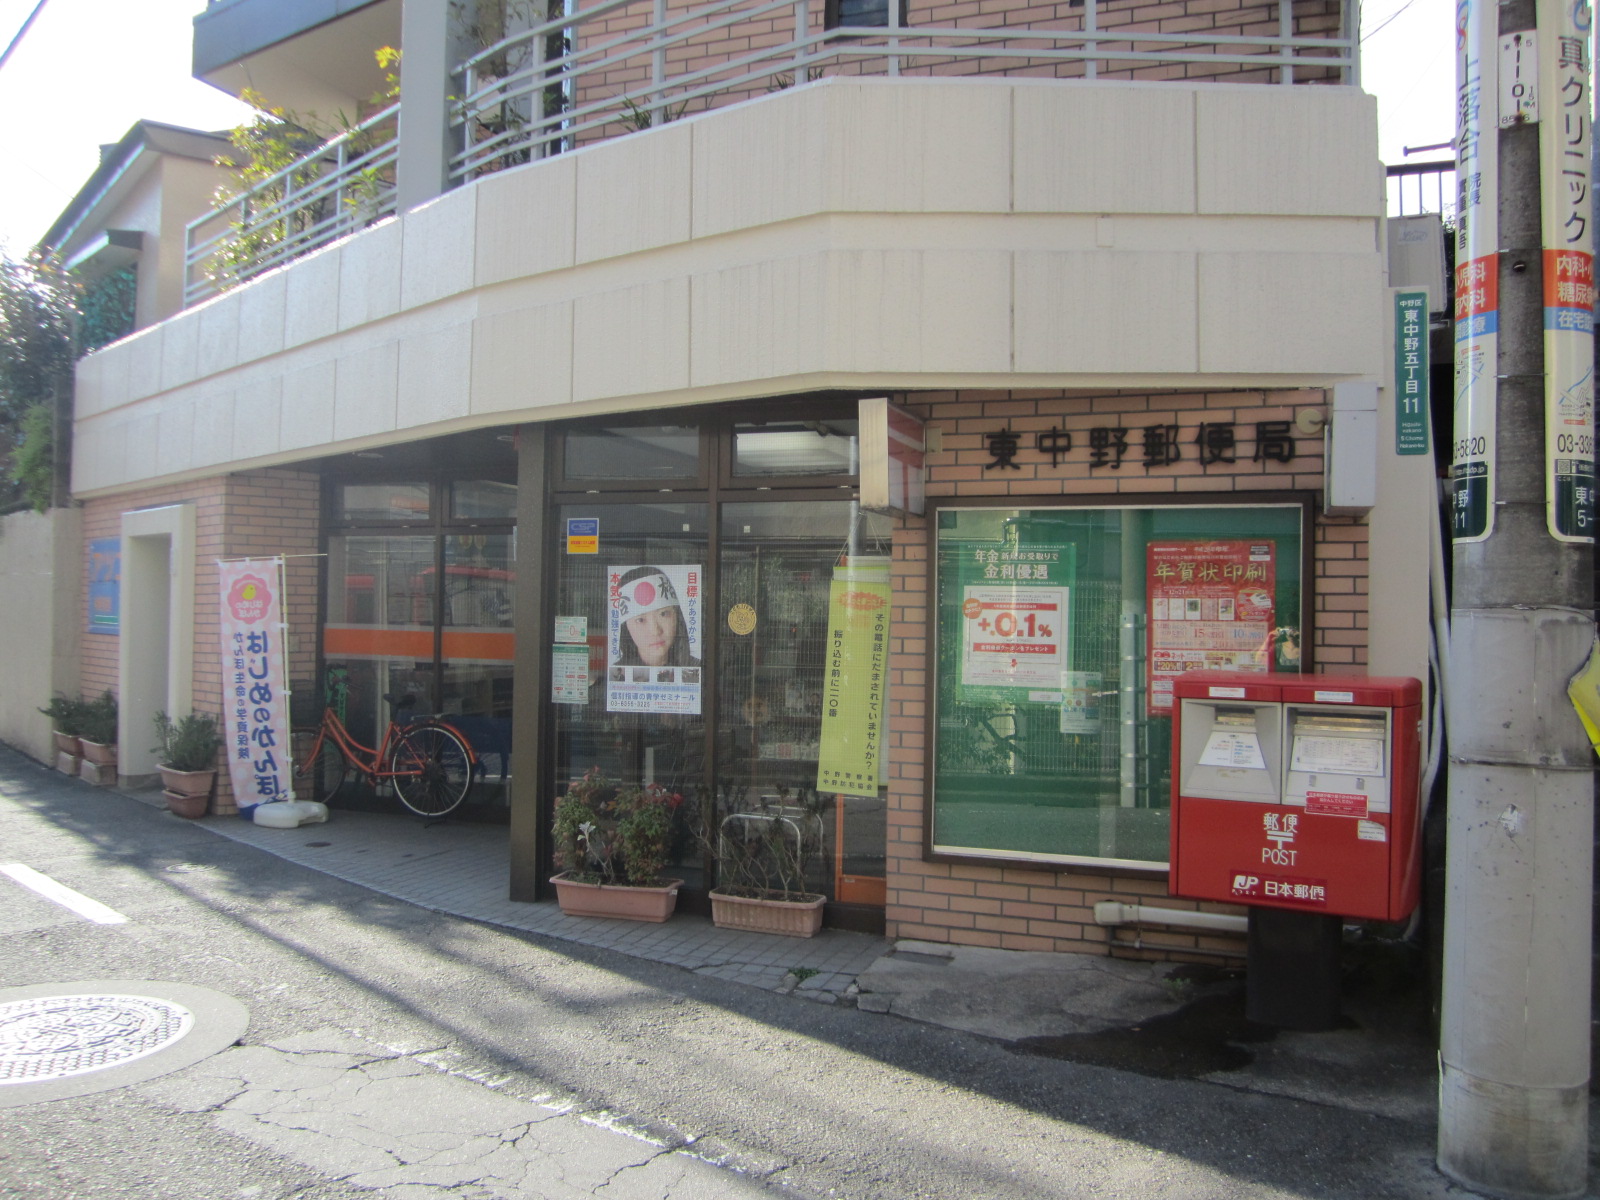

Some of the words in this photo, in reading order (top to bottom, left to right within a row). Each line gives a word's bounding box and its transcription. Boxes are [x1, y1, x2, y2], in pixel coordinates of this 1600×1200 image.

[1557, 35, 1587, 243] 真クリニック
[1399, 299, 1423, 308] 中野区
[984, 420, 1296, 471] 東中野郵便局
[974, 549, 999, 564] 年金
[1001, 552, 1060, 562] 新規お受取りで
[983, 564, 1049, 580] 金利優遇
[1153, 561, 1267, 584] 年賀状印刷
[686, 571, 699, 645] 目標があるから
[1263, 812, 1298, 833] 郵便
[1262, 847, 1298, 866] POST
[1233, 875, 1259, 890] JP
[1265, 881, 1325, 901] 日本郵便
